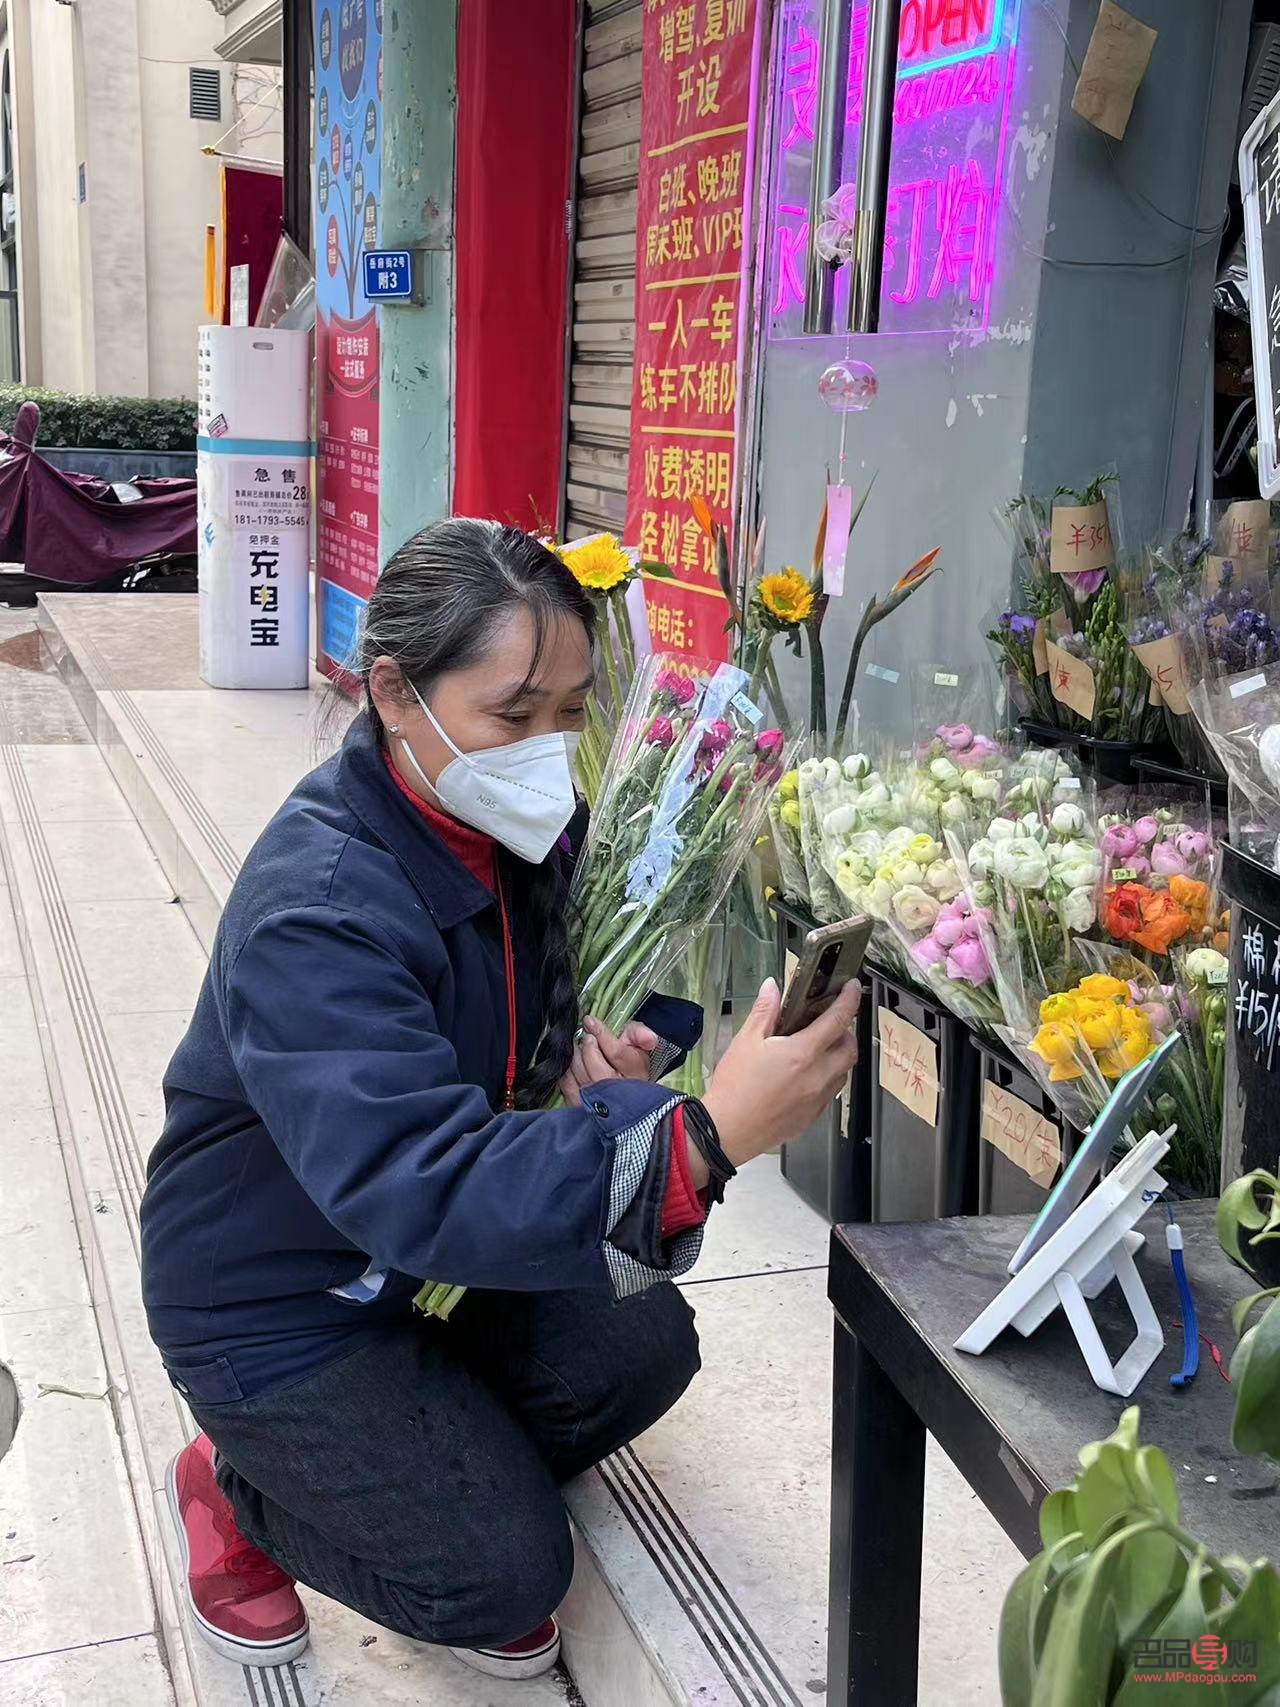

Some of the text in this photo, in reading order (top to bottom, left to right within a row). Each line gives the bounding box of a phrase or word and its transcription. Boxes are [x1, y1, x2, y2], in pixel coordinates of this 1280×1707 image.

[899, 0, 987, 58] OPEN
[677, 54, 722, 127] 开设
[659, 148, 742, 214] 白班、晚班
[378, 272, 398, 289] 附3
[647, 294, 735, 349] 一人一车
[640, 360, 736, 414] 练车不排队
[254, 467, 297, 483] 急售
[644, 445, 731, 509] 收费透明
[234, 515, 305, 526] 181-1793-5545
[249, 534, 280, 545] 免押金
[249, 550, 280, 646] 充电宝
[476, 794, 497, 809] N95
[1235, 978, 1280, 1047] ¥15/
